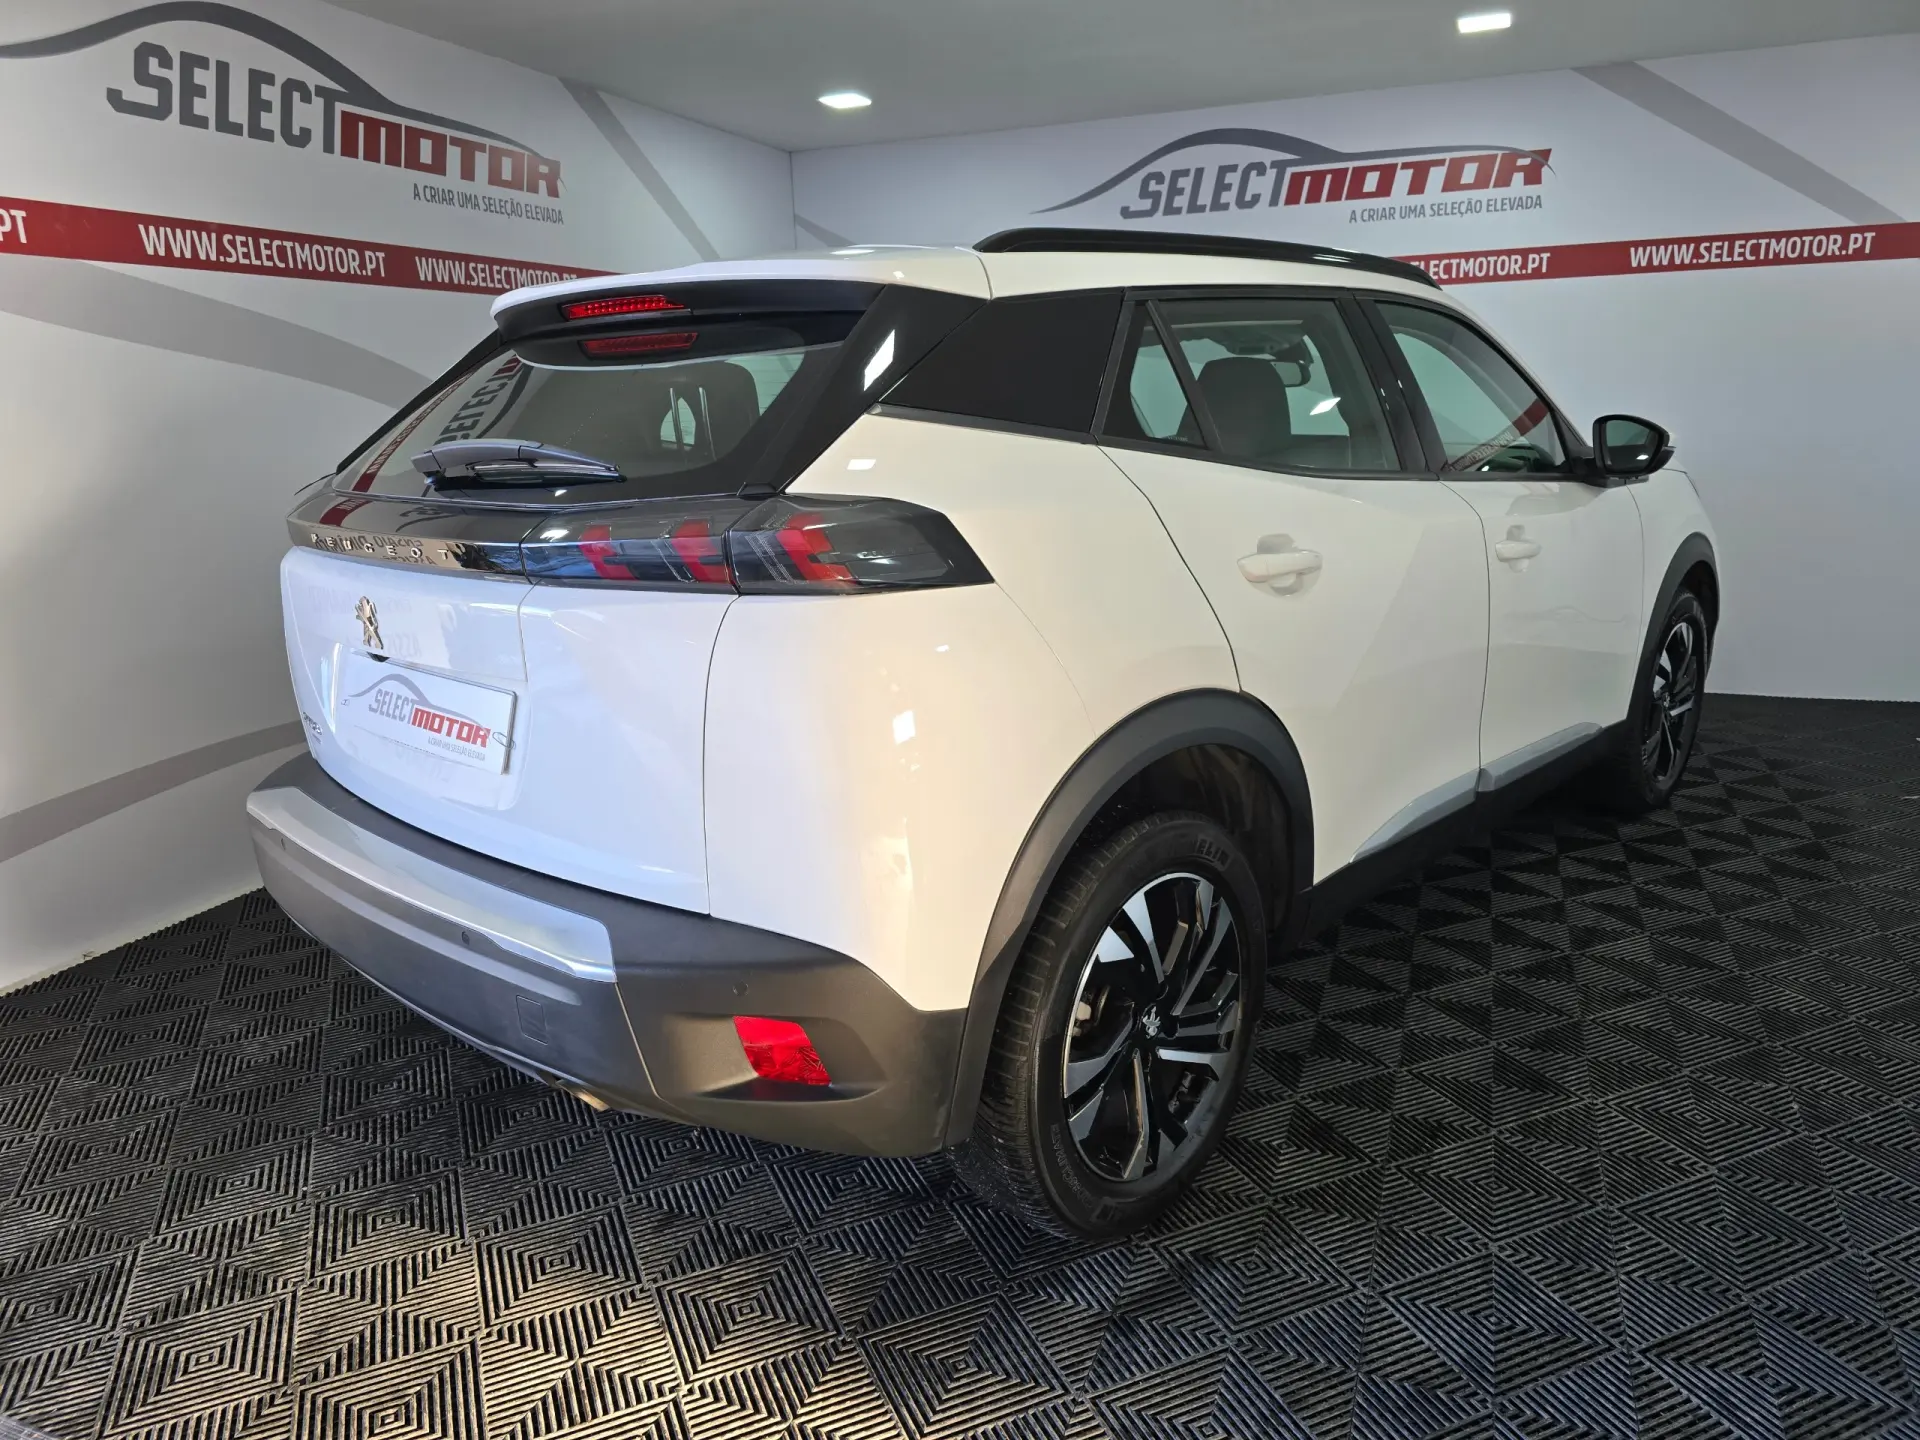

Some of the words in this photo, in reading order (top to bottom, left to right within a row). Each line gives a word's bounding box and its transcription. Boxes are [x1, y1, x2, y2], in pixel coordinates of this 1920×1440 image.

[106, 41, 562, 198] SELECTMOTOR
[413, 183, 421, 201] A
[423, 185, 455, 207] CRIAR
[457, 191, 481, 211] UMA
[483, 195, 523, 219] SELEÇÃO
[525, 203, 564, 225] ELEVADA
[1120, 148, 1552, 219] SELECTMOTOR
[1349, 210, 1358, 224] A
[1360, 206, 1397, 223] CRIAR
[1400, 204, 1426, 219] UMA
[1429, 197, 1482, 218] SELEÇÃO
[1486, 194, 1543, 213] ELEVADA
[138, 224, 386, 278] WWW.SELECTMOTOR.PT
[1630, 232, 1875, 268] WWW.SELECTMOTOR.PT
[311, 533, 449, 560] PEUGEOT
[368, 688, 491, 748] SELECTMOTOR
